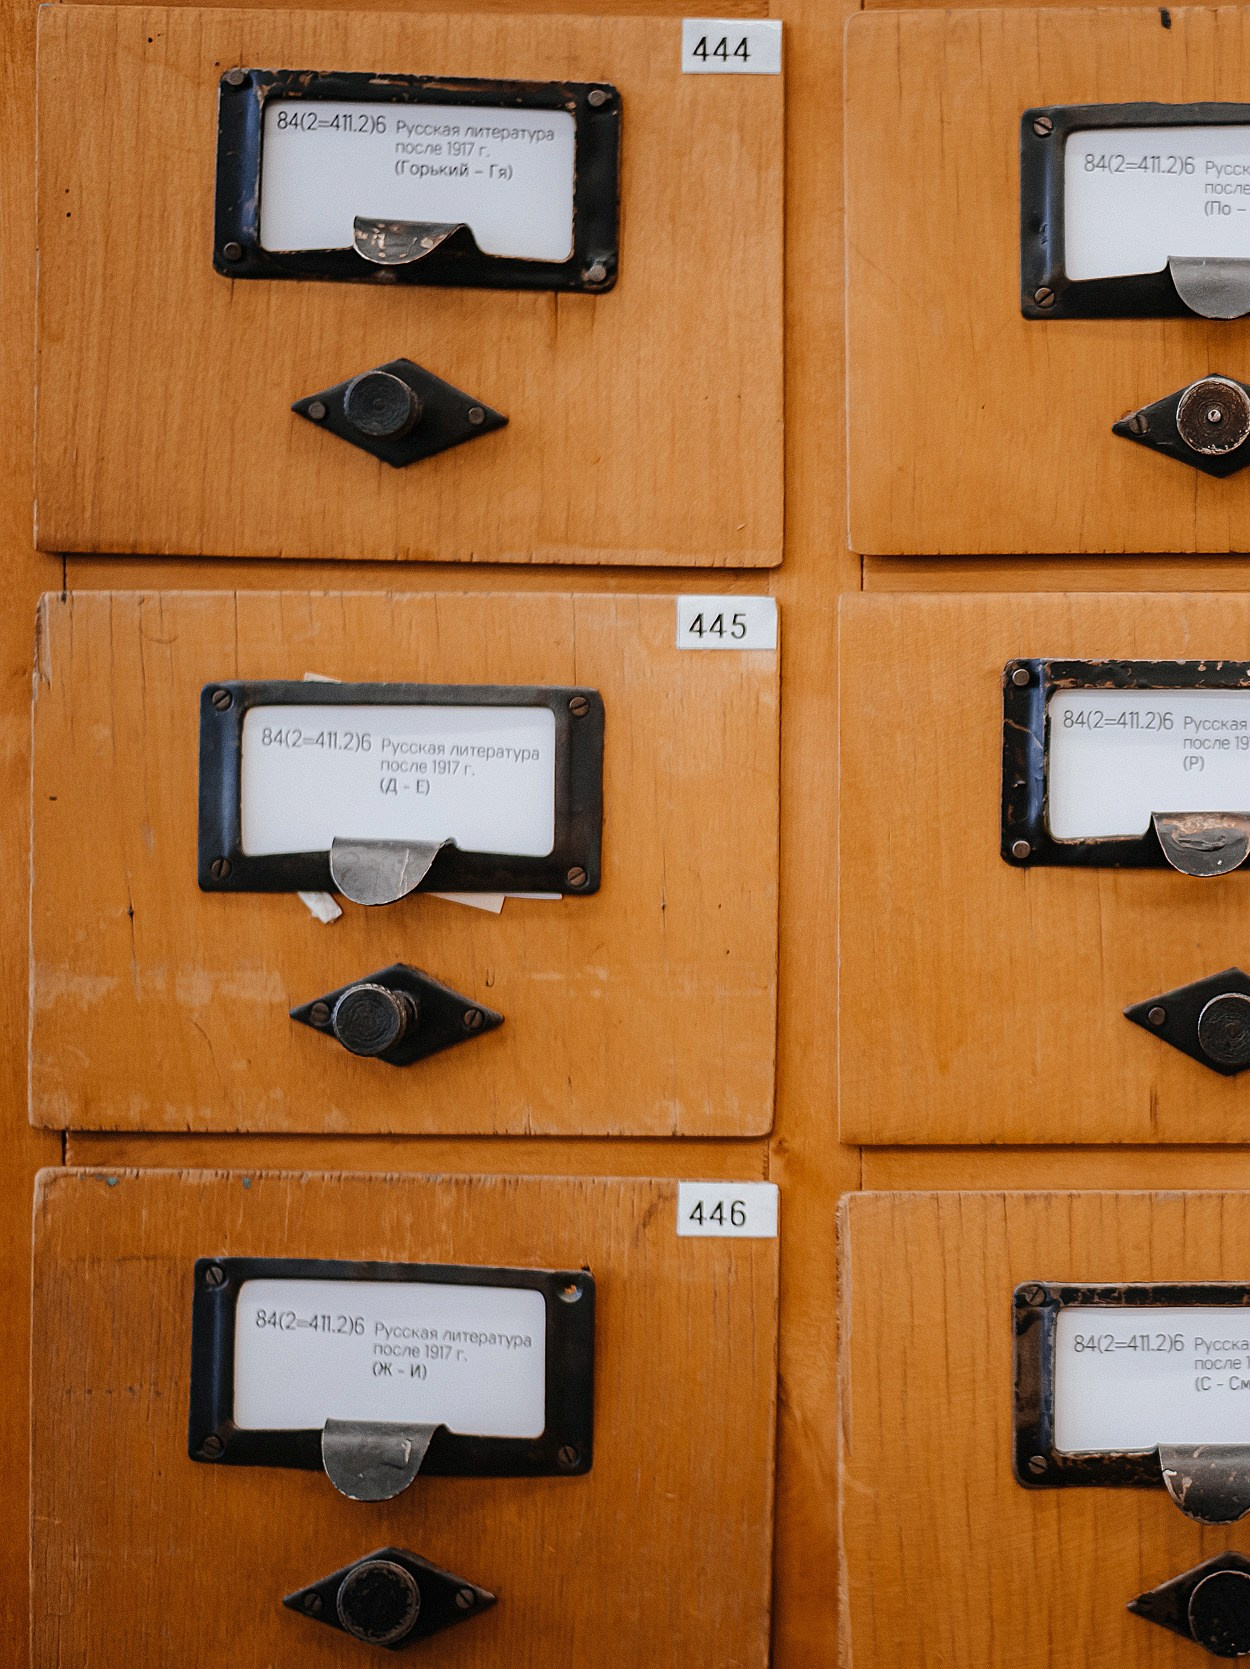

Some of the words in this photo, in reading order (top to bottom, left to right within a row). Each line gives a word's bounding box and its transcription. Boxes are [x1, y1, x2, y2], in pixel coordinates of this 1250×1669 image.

[693, 37, 750, 62] 444
[277, 111, 386, 134] 84(2=411.2)6
[396, 119, 460, 138] Русская
[465, 126, 554, 142] литература
[395, 142, 442, 156] после
[447, 141, 475, 156] 1917
[479, 146, 490, 158] г.
[395, 160, 469, 178] (Горький
[490, 164, 513, 180] Гя)
[1084, 153, 1195, 175] 84(2=411.2)6
[1205, 184, 1250, 195] после
[1204, 201, 1231, 216] (По
[689, 613, 746, 638] 445
[1063, 710, 1173, 731] 84(2=411.2)6
[1184, 716, 1247, 734] Русская
[262, 727, 371, 752] 84(2=411.2)6
[382, 738, 445, 756] Русская
[451, 741, 540, 762] литература
[1184, 738, 1230, 750] после
[381, 760, 427, 773] после
[433, 759, 460, 775] 1917
[465, 765, 475, 776] г.
[1183, 756, 1204, 771] (Р)
[380, 778, 397, 795] (Д
[417, 779, 430, 795] Е)
[689, 1201, 745, 1226] 446
[256, 1309, 364, 1335] 84(2=411.2)6
[375, 1321, 438, 1341] Русская
[443, 1328, 532, 1350] литература
[374, 1344, 420, 1358] после
[425, 1344, 452, 1359] 1917
[456, 1350, 467, 1362] г.
[1074, 1334, 1184, 1354] 84(2=411.2)6
[373, 1362, 392, 1376] (Ж
[411, 1364, 426, 1380] И)
[1195, 1359, 1242, 1370] после
[1195, 1376, 1211, 1392] (С
